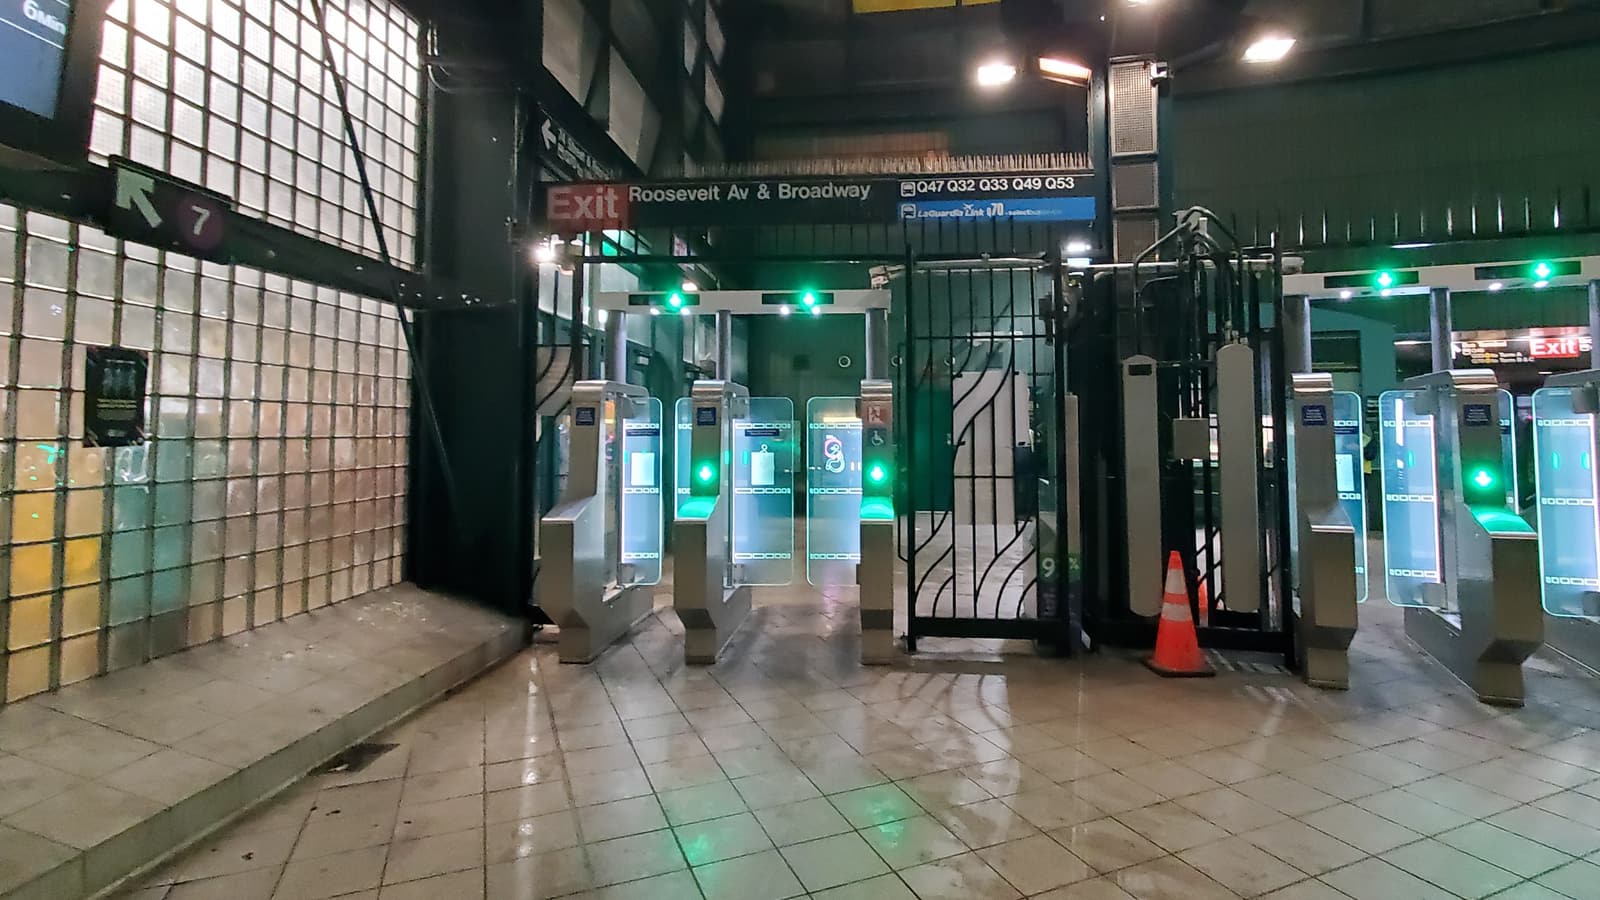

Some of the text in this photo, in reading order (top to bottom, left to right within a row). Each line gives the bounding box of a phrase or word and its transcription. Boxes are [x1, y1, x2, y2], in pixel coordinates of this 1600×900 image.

[629, 182, 871, 202] Roosevelt Av & Broadway
[917, 177, 1075, 193] Q47 Q32 Q33 Q49 Q53
[547, 187, 619, 219] Exit
[191, 205, 211, 236] 7
[917, 209, 964, 218] LaGuardia
[965, 208, 985, 217] Link
[1530, 337, 1577, 355] Exit
